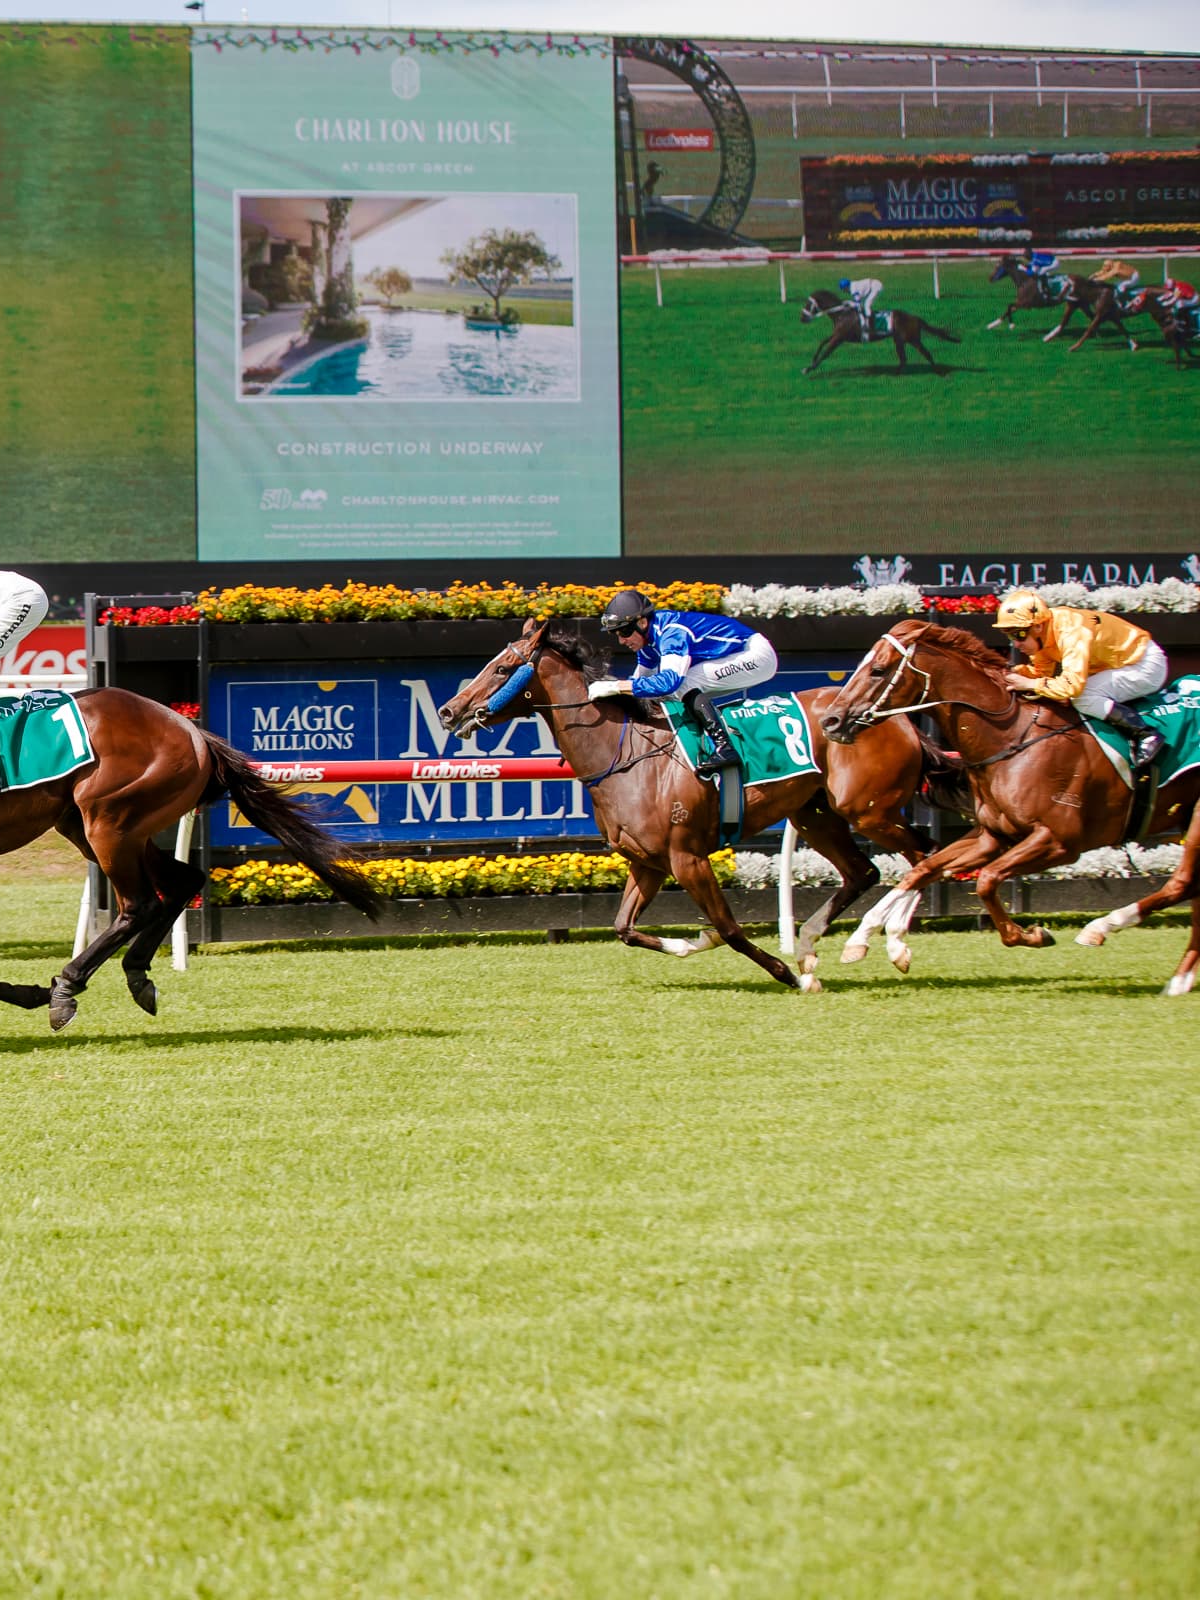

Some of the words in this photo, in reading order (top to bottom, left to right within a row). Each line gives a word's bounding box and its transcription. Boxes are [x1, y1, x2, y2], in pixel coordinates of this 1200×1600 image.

[295, 117, 426, 143] CHARLTON
[437, 120, 517, 144] HOUSE
[886, 177, 977, 202] MAGIC
[1064, 188, 1128, 203] ASCOT
[1136, 186, 1200, 201] GREEN
[887, 202, 977, 221] MILLIONS
[277, 441, 432, 456] CONSTRUCTION
[439, 440, 544, 455] UNDERWAY
[938, 562, 1048, 587] EAGLE
[1061, 562, 1158, 587] FARM
[251, 704, 355, 732] MAGIC
[51, 702, 86, 760] 1
[252, 732, 355, 752] MILLIONS
[777, 714, 811, 767] 8
[411, 761, 503, 780] Ladbrokes
[399, 780, 590, 824] MILLI
